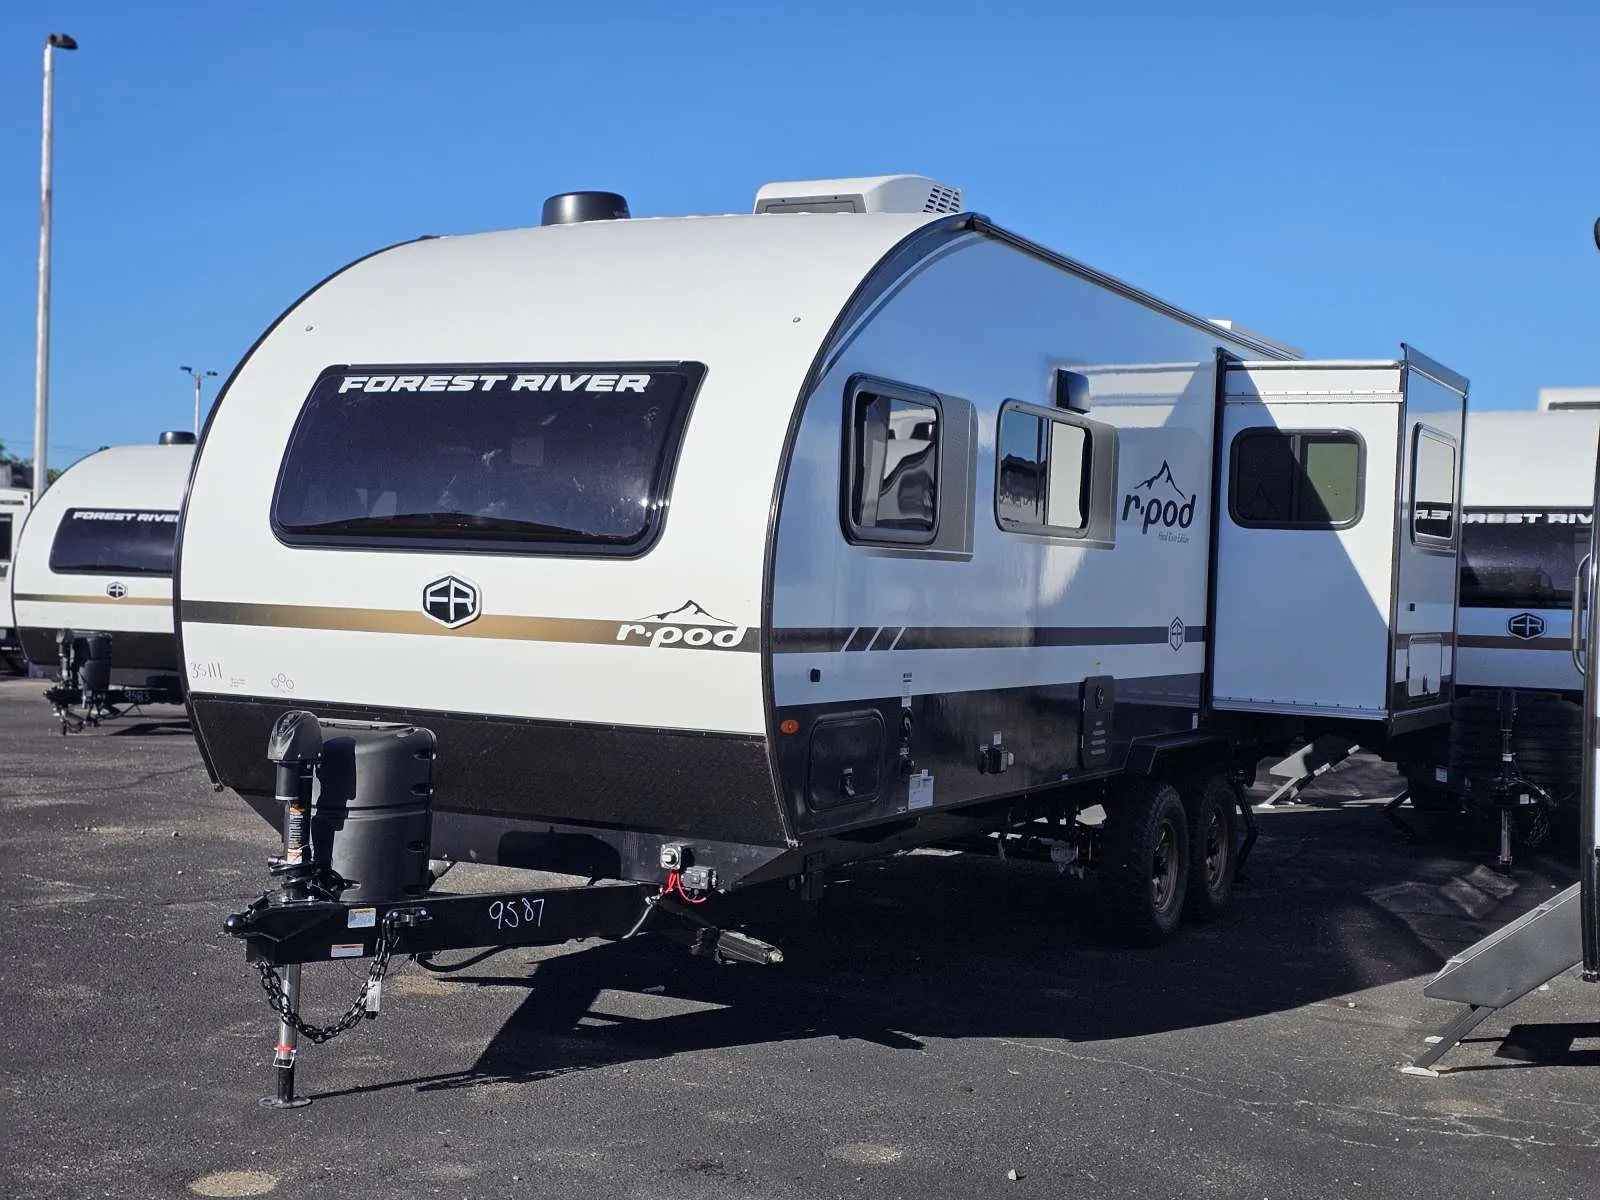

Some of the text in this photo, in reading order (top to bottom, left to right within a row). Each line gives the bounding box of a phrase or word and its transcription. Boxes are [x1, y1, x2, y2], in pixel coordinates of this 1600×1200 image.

[338, 374, 651, 393] FOREST RIVER
[73, 511, 136, 521] FOREST
[488, 897, 545, 930] 9587
